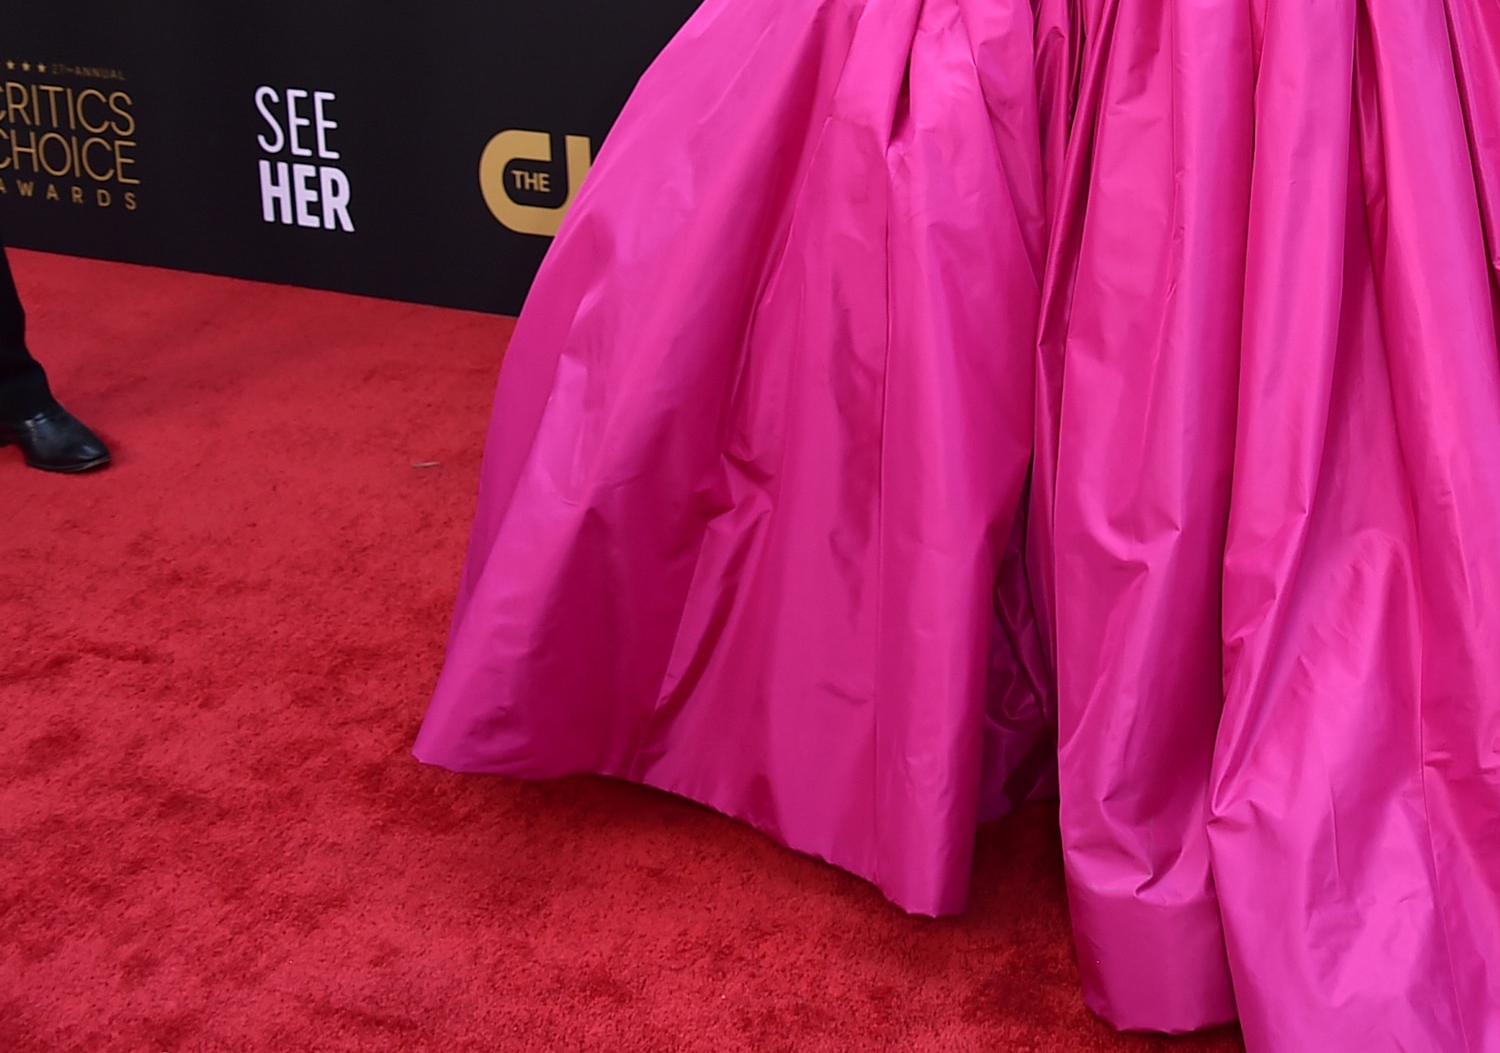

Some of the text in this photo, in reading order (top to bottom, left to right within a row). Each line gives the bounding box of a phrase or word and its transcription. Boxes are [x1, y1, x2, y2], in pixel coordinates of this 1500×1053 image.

[0, 80, 136, 137] RITICS
[255, 87, 339, 159] SEE
[259, 160, 354, 231] HER
[512, 170, 550, 192] THE
